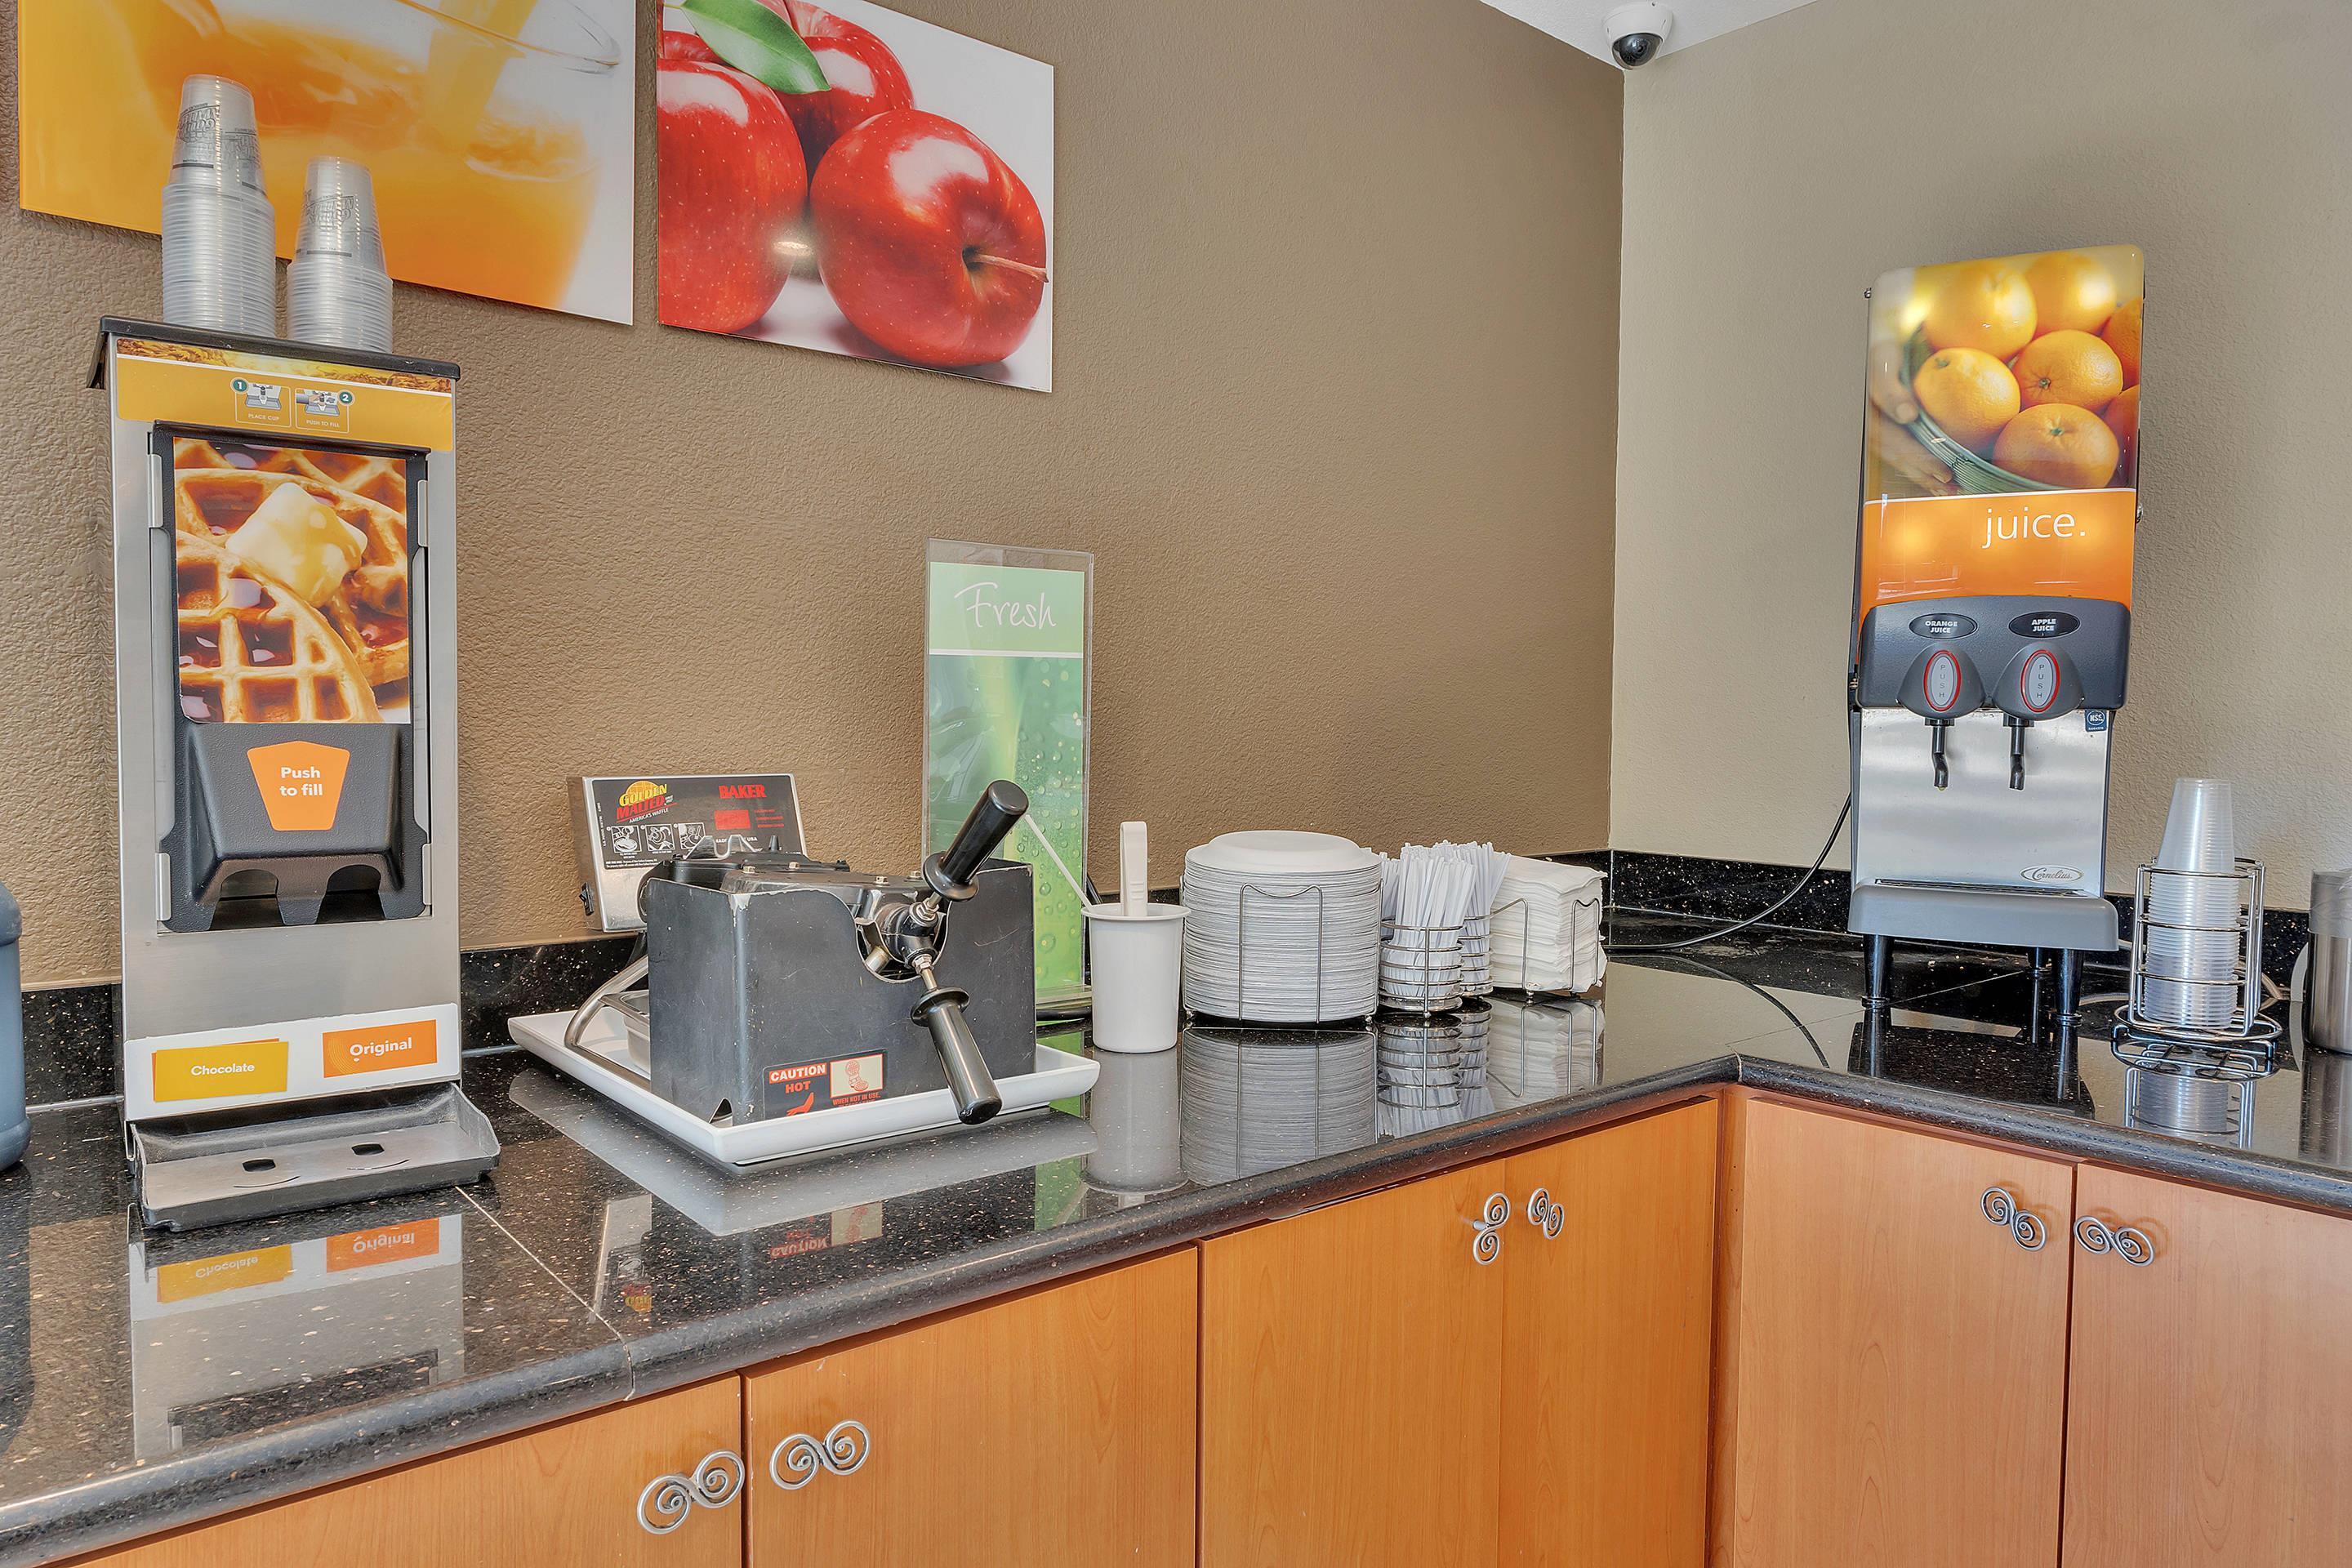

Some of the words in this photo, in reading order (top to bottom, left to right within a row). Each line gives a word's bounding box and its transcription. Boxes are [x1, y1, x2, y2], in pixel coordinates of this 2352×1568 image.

[237, 381, 243, 390] 1
[1981, 506, 2086, 549] juice.
[954, 581, 1056, 630] Fresh
[2037, 664, 2045, 698] PUSH
[280, 766, 321, 778] Push
[279, 785, 298, 796] to
[301, 783, 323, 796] fill
[619, 783, 667, 807] GOLDEN
[719, 784, 767, 799] BAKER
[616, 795, 666, 820] MALTED
[350, 1037, 412, 1058] Original
[190, 1062, 256, 1076] Chocolate
[770, 1063, 826, 1082] CAUTION
[785, 1080, 811, 1094] HOT
[833, 1097, 849, 1106] WHEN
